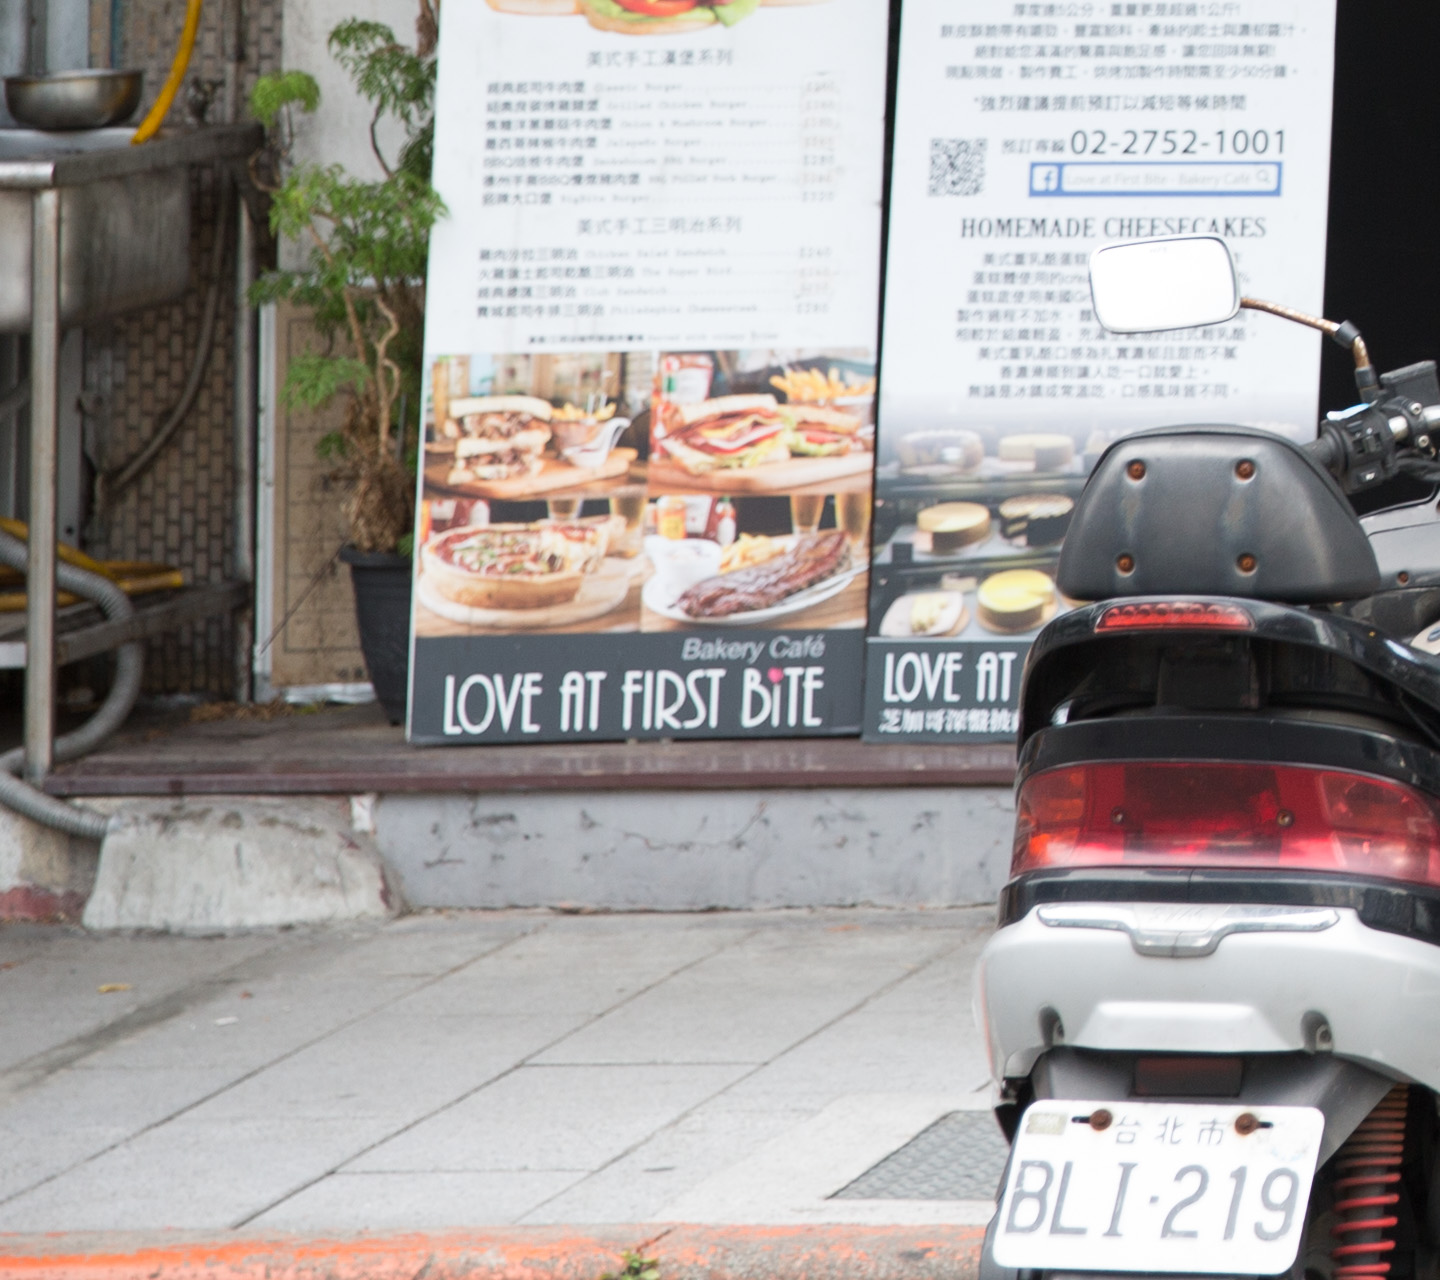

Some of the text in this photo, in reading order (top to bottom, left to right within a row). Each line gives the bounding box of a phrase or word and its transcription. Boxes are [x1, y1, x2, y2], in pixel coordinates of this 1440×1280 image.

[1070, 128, 1286, 156] 02-2752-1001
[1067, 172, 1094, 186] Love
[1099, 173, 1112, 186] at
[1114, 172, 1140, 186] First
[1143, 172, 1166, 186] Bite
[1178, 171, 1219, 189] Bakery
[1222, 171, 1251, 186] Café
[960, 216, 1267, 240] HOMEMADE CHEESECAKES
[682, 633, 826, 665] Bakery Café
[883, 650, 1018, 704] LOVE AT
[443, 672, 544, 736] LOVE
[559, 670, 607, 732] AT
[621, 667, 727, 731] FIRST
[1115, 1115, 1226, 1147] 台北市
